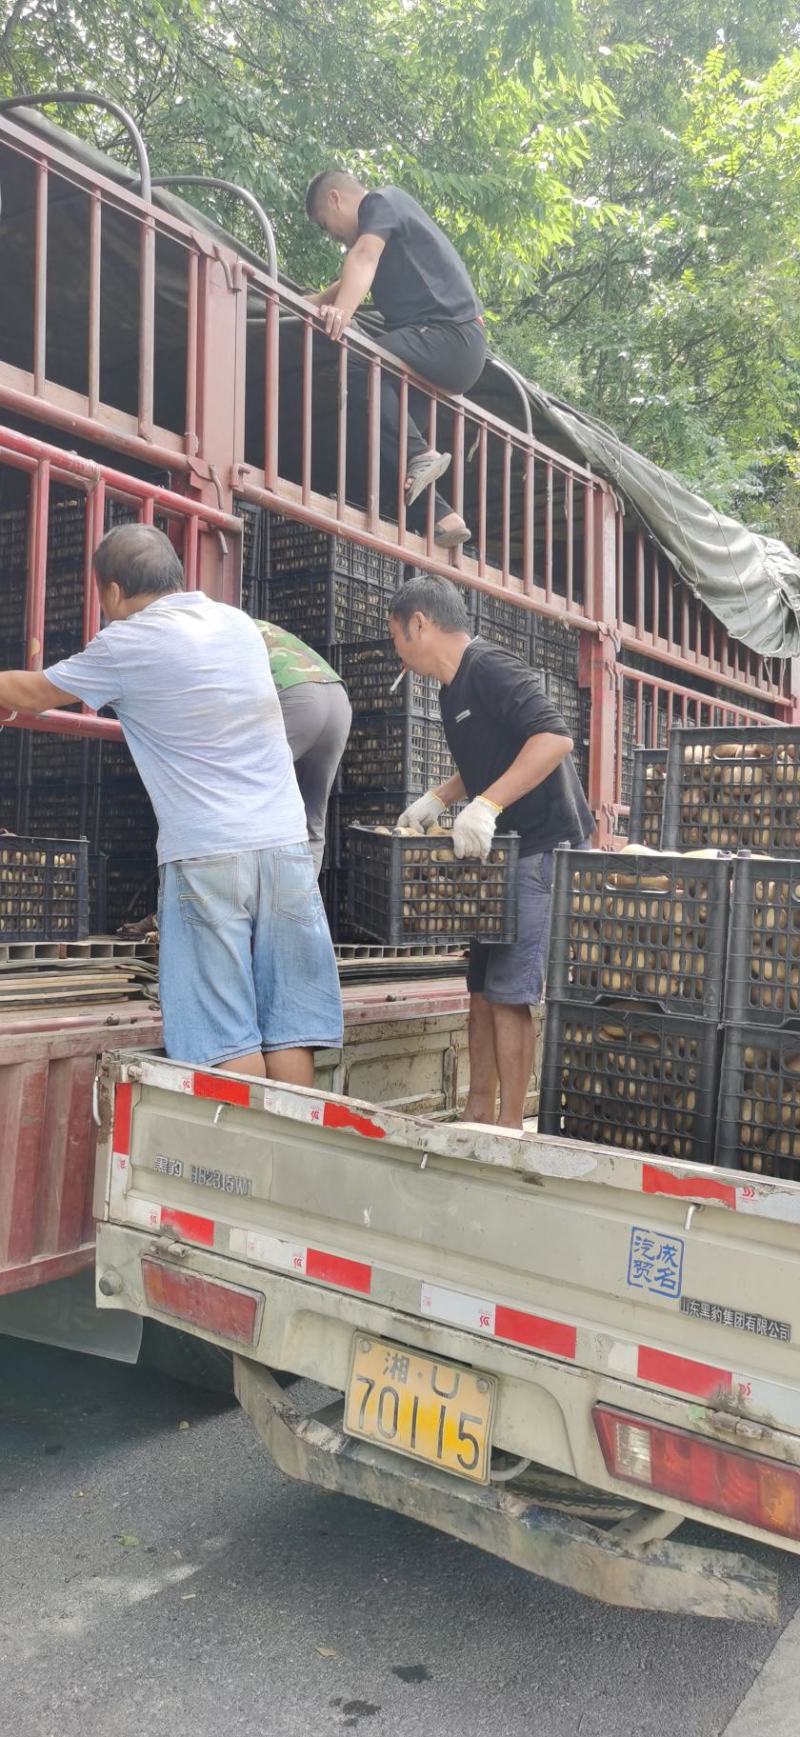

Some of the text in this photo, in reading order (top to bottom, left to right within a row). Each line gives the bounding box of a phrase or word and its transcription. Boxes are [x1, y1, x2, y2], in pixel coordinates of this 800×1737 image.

[681, 1297, 791, 1342] 山东黑豹集团有限公司
[356, 1376, 483, 1470] 70115
